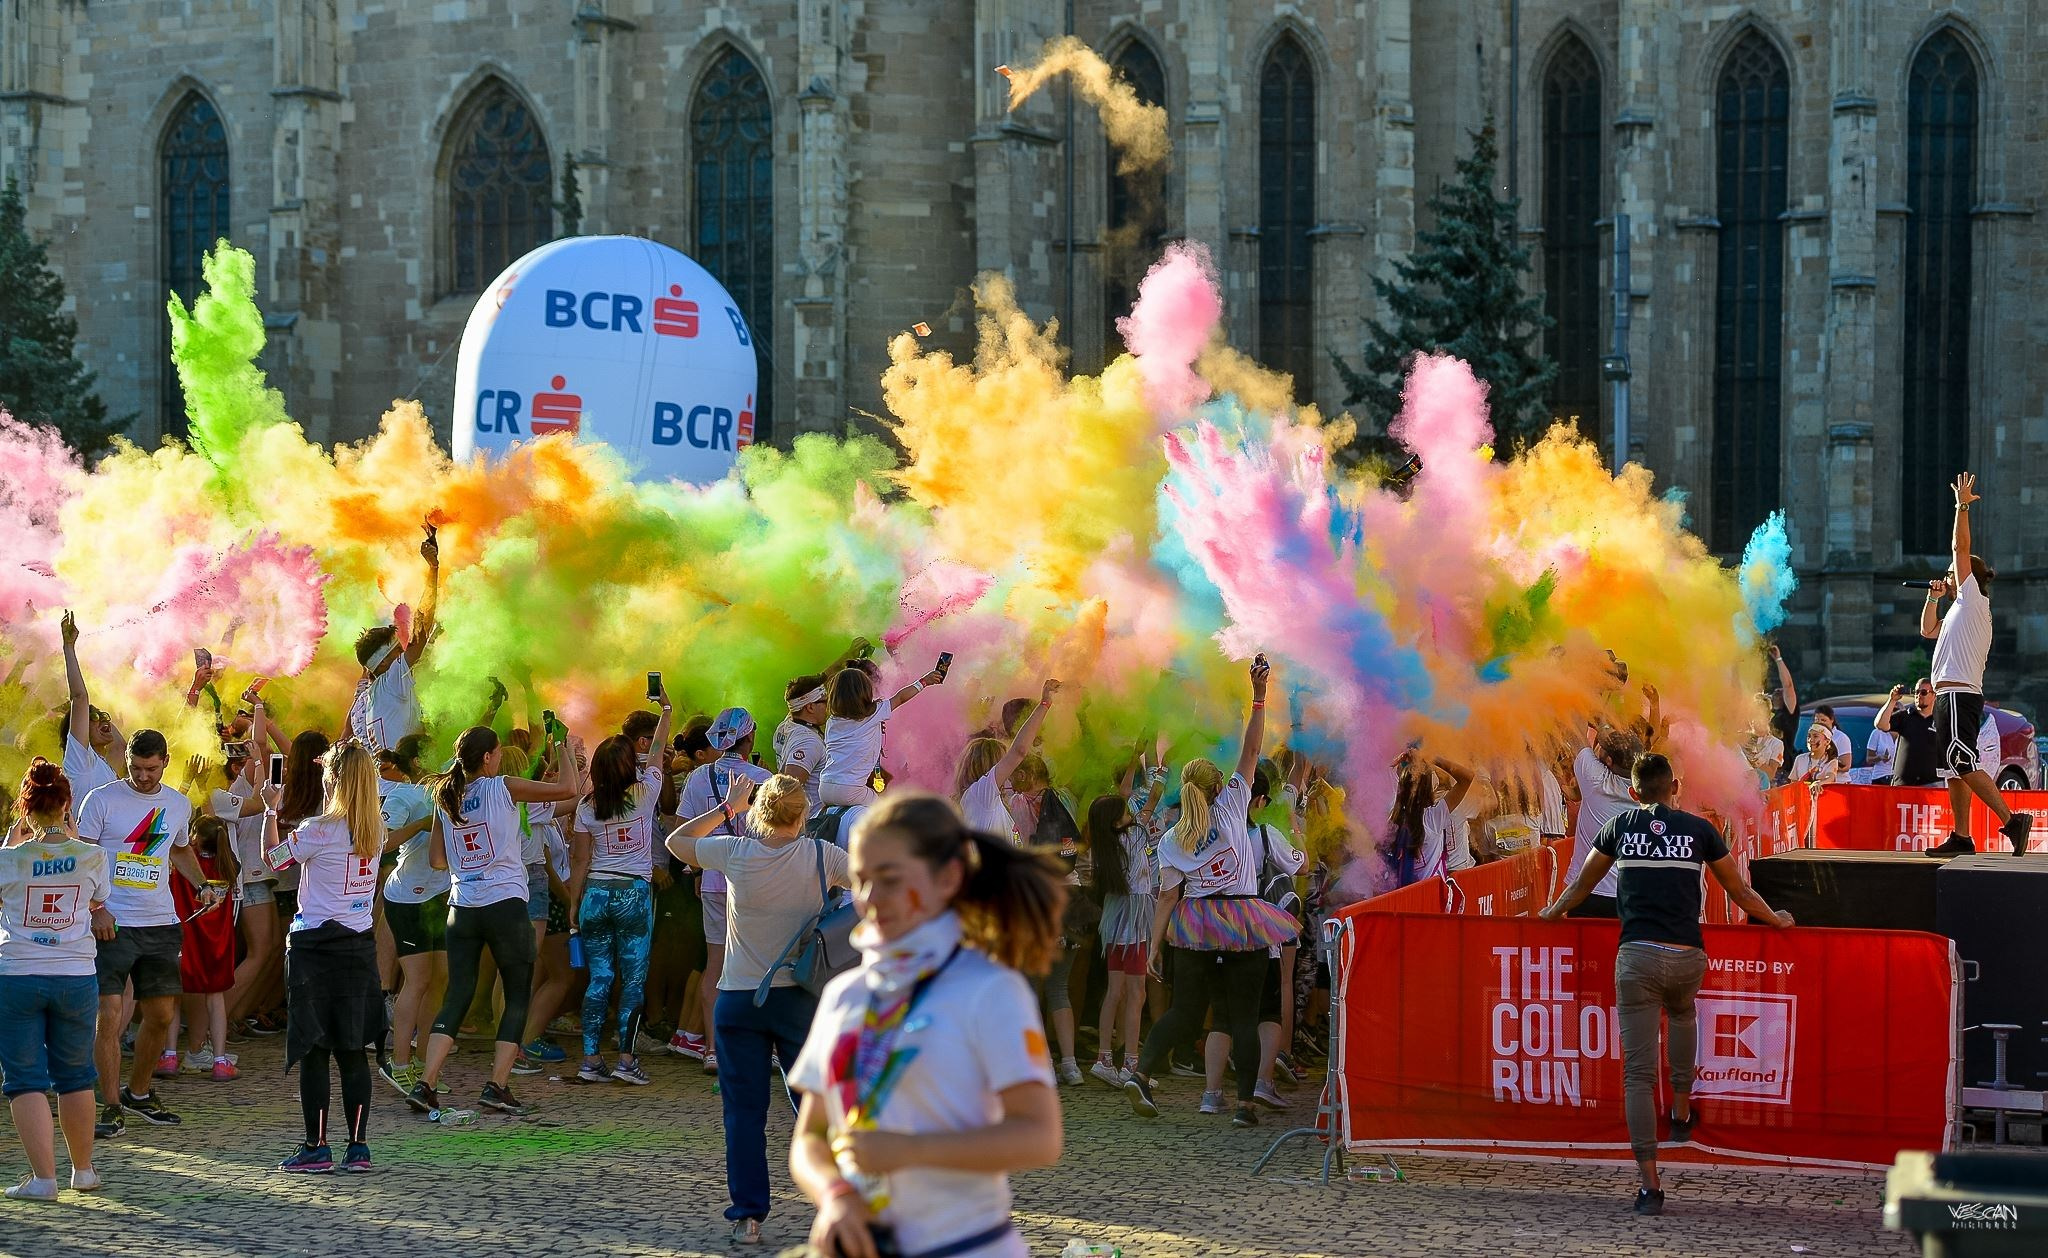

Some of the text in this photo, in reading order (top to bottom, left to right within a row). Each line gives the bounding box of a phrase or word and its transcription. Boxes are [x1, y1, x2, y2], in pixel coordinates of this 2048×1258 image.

[545, 289, 643, 334] BCR
[652, 401, 733, 452] BCR
[461, 796, 481, 814] RO
[1897, 804, 1942, 835] THE
[1622, 832, 1694, 847] ML VIP
[1622, 843, 1693, 859] GUARD
[32, 855, 77, 879] DERO
[127, 867, 149, 880] 32651
[30, 915, 71, 925] Kaufland
[33, 936, 49, 944] BCR
[1492, 947, 1574, 1000] THE
[1708, 958, 1794, 975] WERED BY
[1695, 1065, 1777, 1083] Kaufland
[1492, 1059, 1582, 1108] RUN
